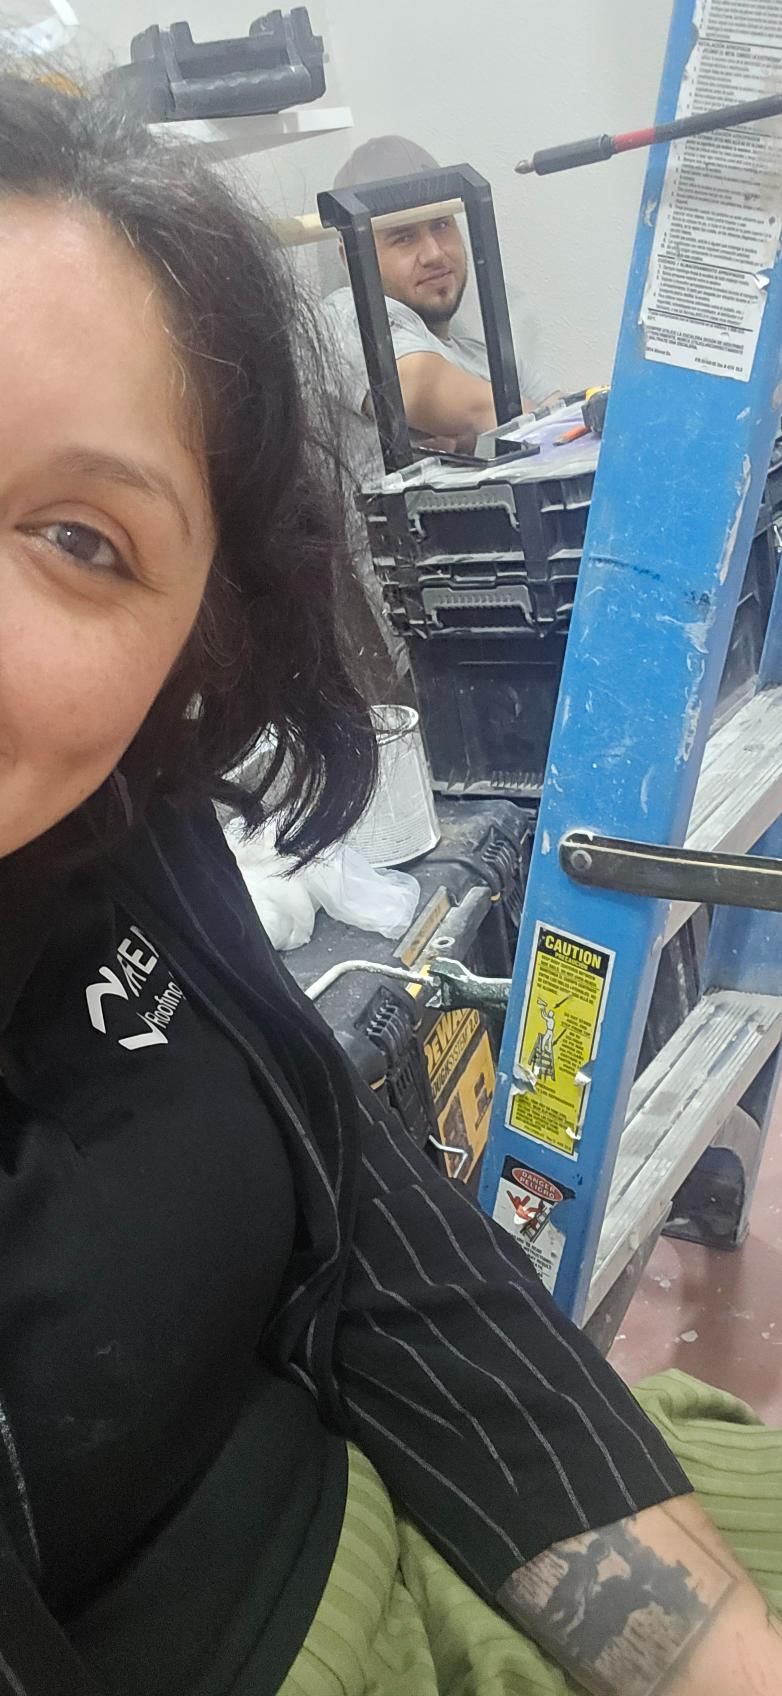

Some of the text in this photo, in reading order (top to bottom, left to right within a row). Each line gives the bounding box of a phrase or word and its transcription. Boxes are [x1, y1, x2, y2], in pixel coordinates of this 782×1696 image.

[545, 935, 602, 970] CAUTION
[519, 1176, 555, 1200] PELIGRO
[521, 1171, 556, 1193] DANGER
